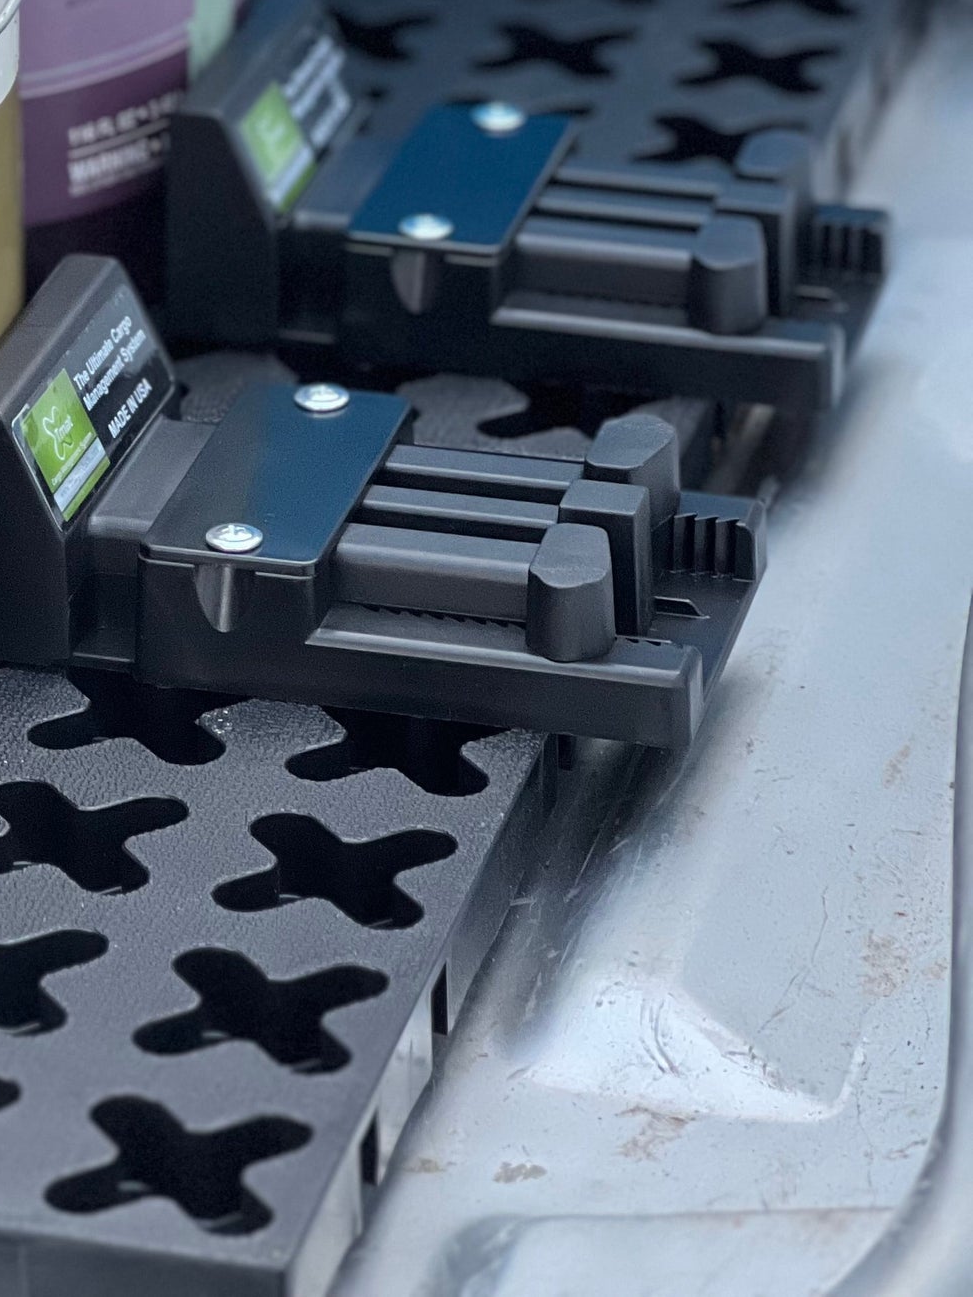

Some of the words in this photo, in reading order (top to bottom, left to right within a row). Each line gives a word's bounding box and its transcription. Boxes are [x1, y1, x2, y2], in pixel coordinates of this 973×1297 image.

[73, 369, 90, 391] The
[85, 338, 114, 375] Ultimate
[110, 315, 132, 343] Cargo
[82, 354, 126, 411] Management
[119, 329, 146, 363] System
[107, 404, 132, 439] MADE
[126, 394, 138, 414] IN
[133, 377, 153, 404] USA
